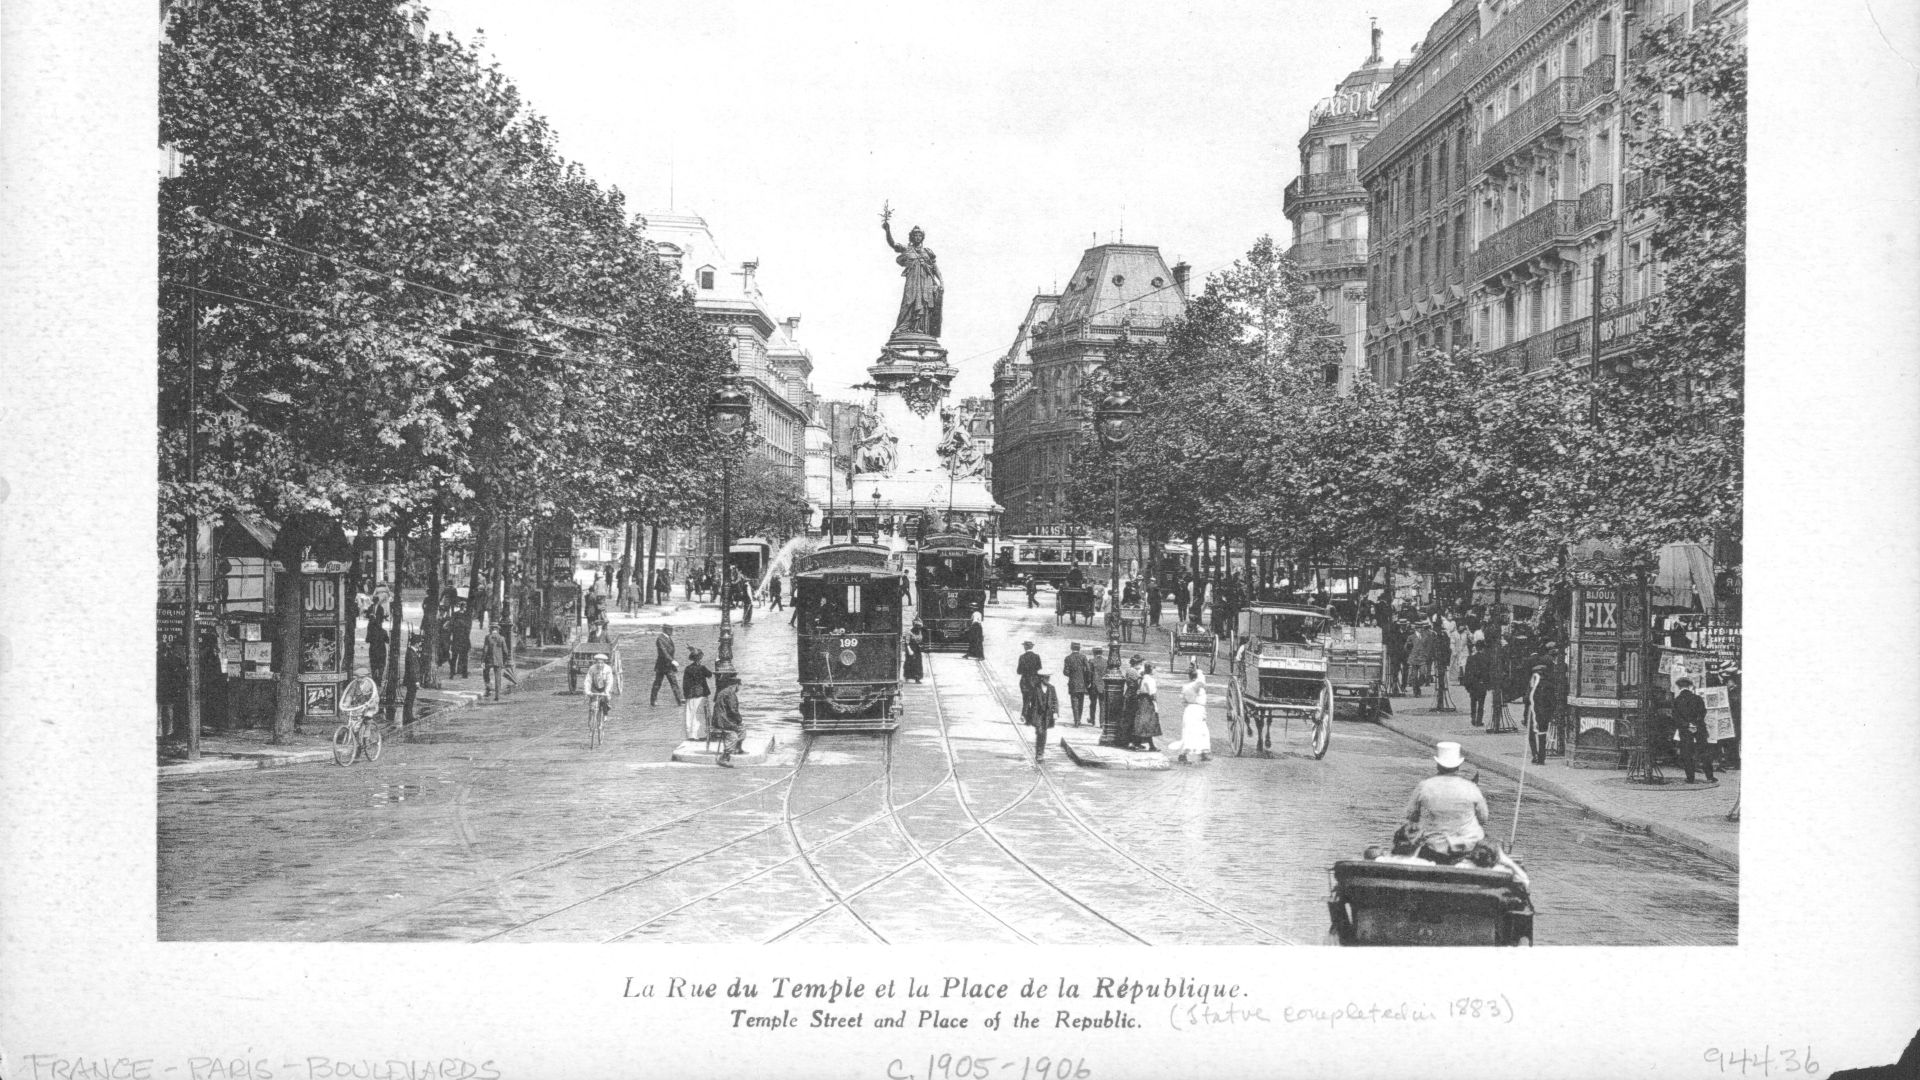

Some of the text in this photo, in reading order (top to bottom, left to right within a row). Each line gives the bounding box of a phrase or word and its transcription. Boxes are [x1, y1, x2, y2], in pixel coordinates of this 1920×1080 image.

[305, 580, 335, 610] JOB
[1586, 590, 1616, 600] BIJOUX
[1584, 602, 1617, 629] FIX
[840, 638, 859, 648] 199
[307, 687, 333, 705] ZAN
[1580, 717, 1615, 736] SUNLIGHT
[24, 1053, 154, 1080] FRANCE
[1703, 1044, 1820, 1078] 944.36
